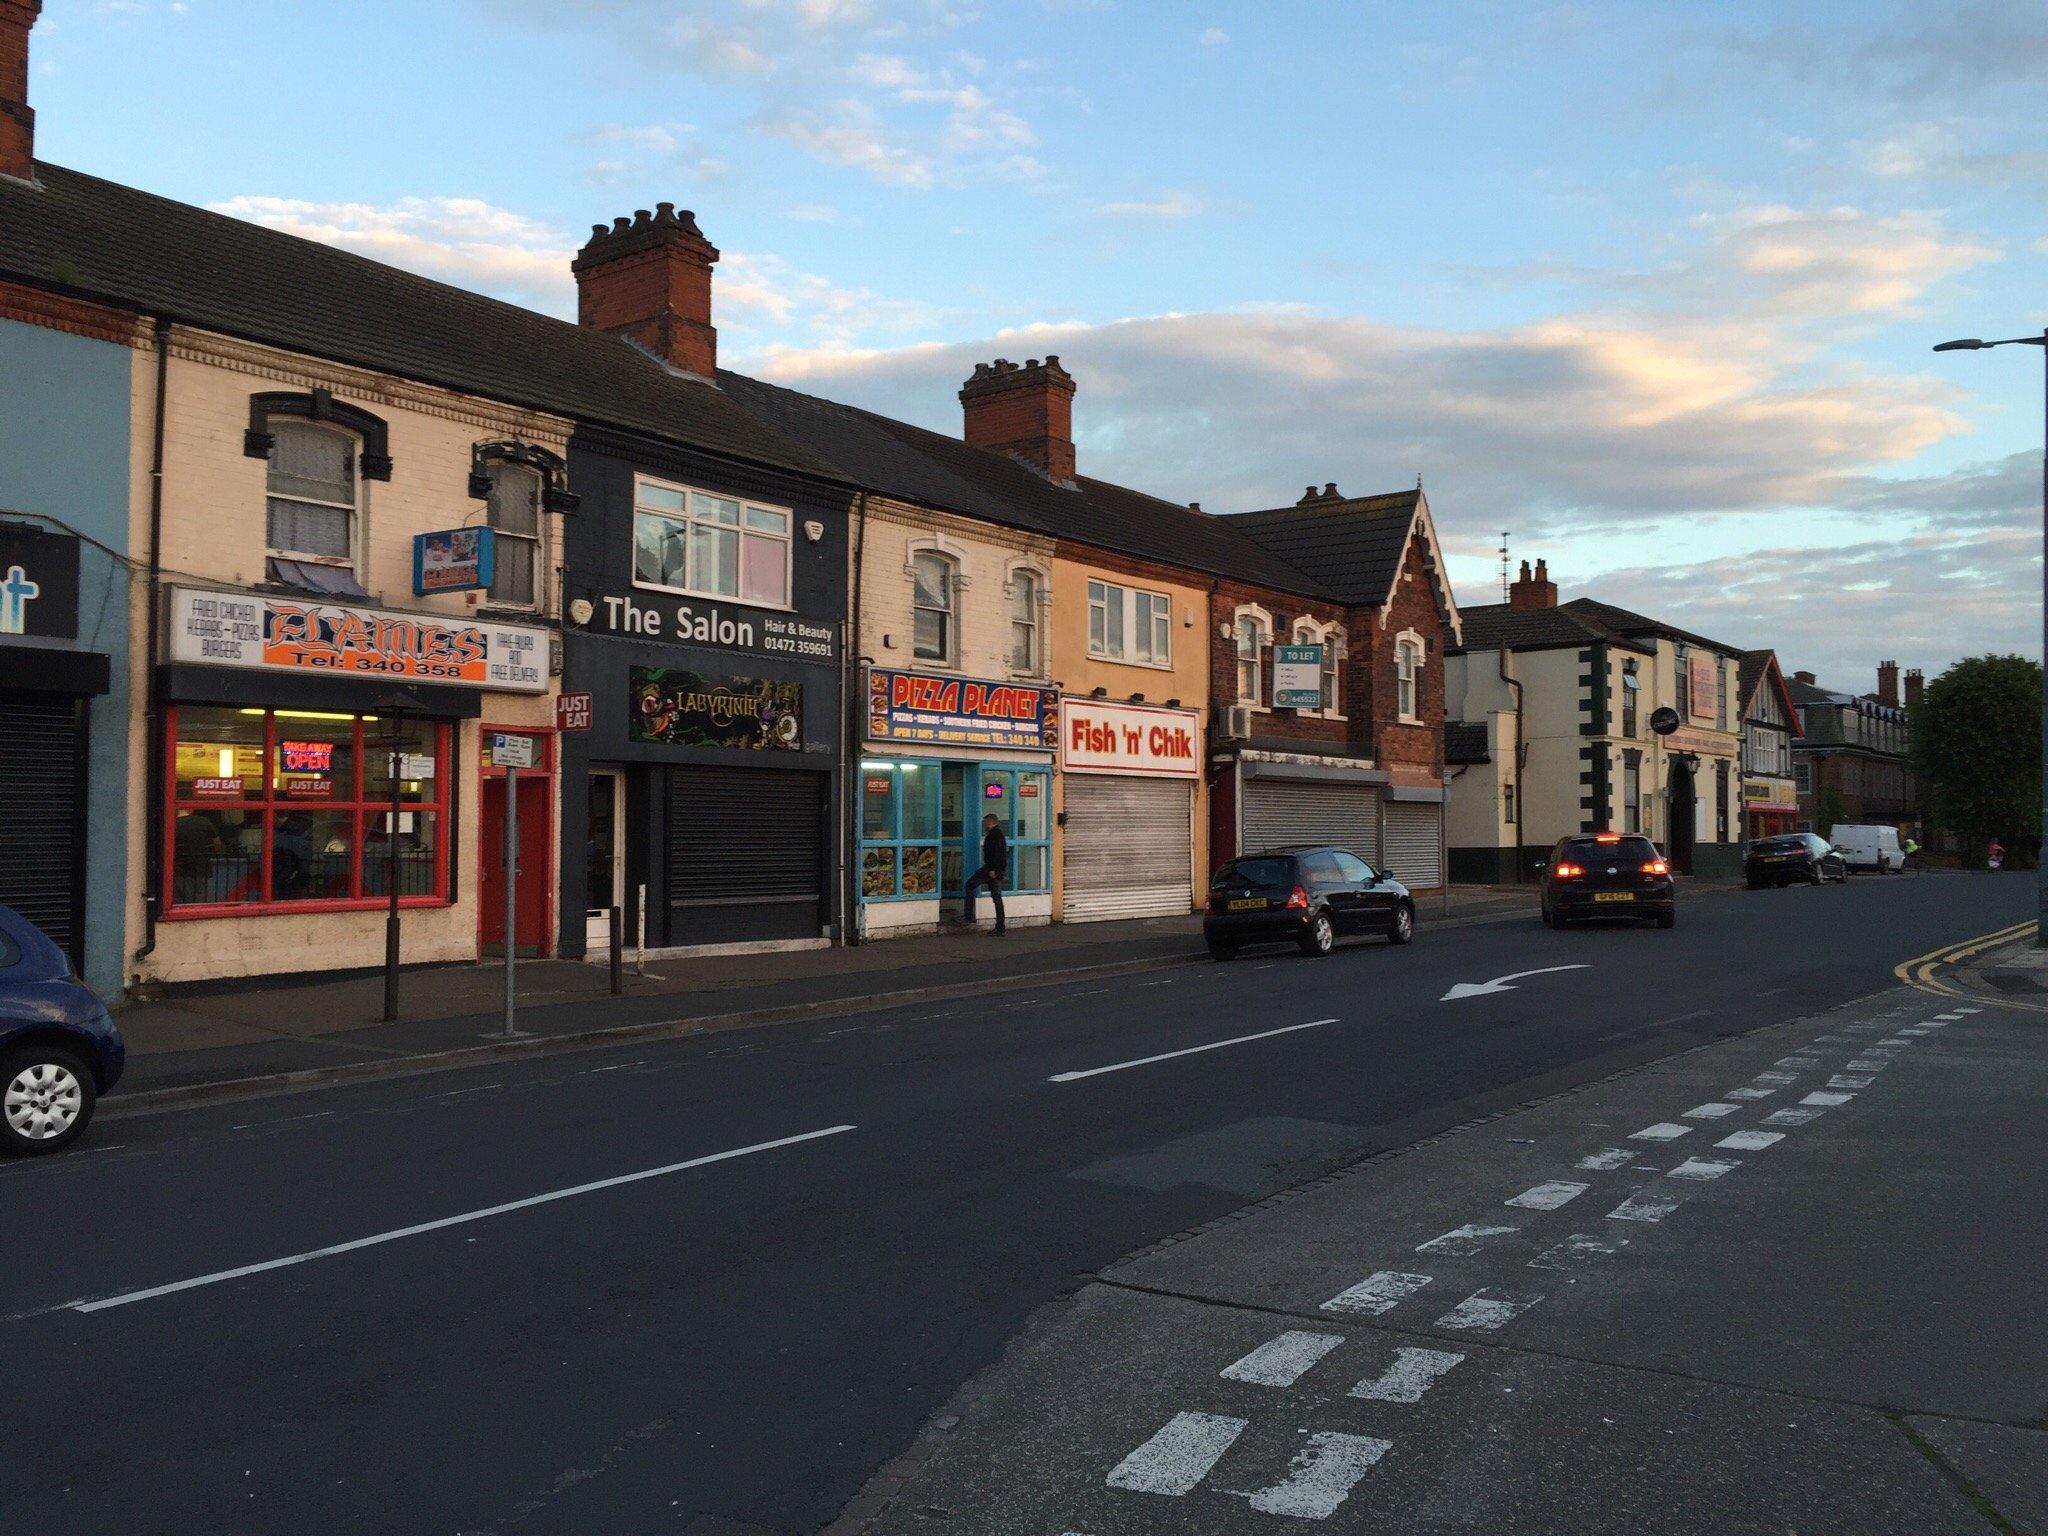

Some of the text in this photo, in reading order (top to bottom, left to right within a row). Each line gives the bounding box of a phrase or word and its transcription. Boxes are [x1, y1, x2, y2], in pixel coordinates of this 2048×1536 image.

[603, 595, 754, 647] The Salon
[265, 601, 487, 664] FLAMES
[765, 619, 832, 642] Hair & Beauty
[764, 637, 833, 657] 01472 359691
[1287, 652, 1314, 660] TO LET
[290, 652, 462, 678] Tel: 340 358
[558, 695, 589, 712] JUST
[676, 690, 761, 719] LABYRINTH
[892, 674, 1039, 720] PIZZA PLANET
[566, 712, 589, 728] EAT
[283, 741, 333, 753] TAKE AWAY
[1008, 734, 1023, 745] 340
[1072, 718, 1192, 758] Fish 'n' Chik
[286, 754, 330, 768] OPEN
[195, 780, 241, 789] JUST EAT
[289, 781, 331, 790] JUST EAT
